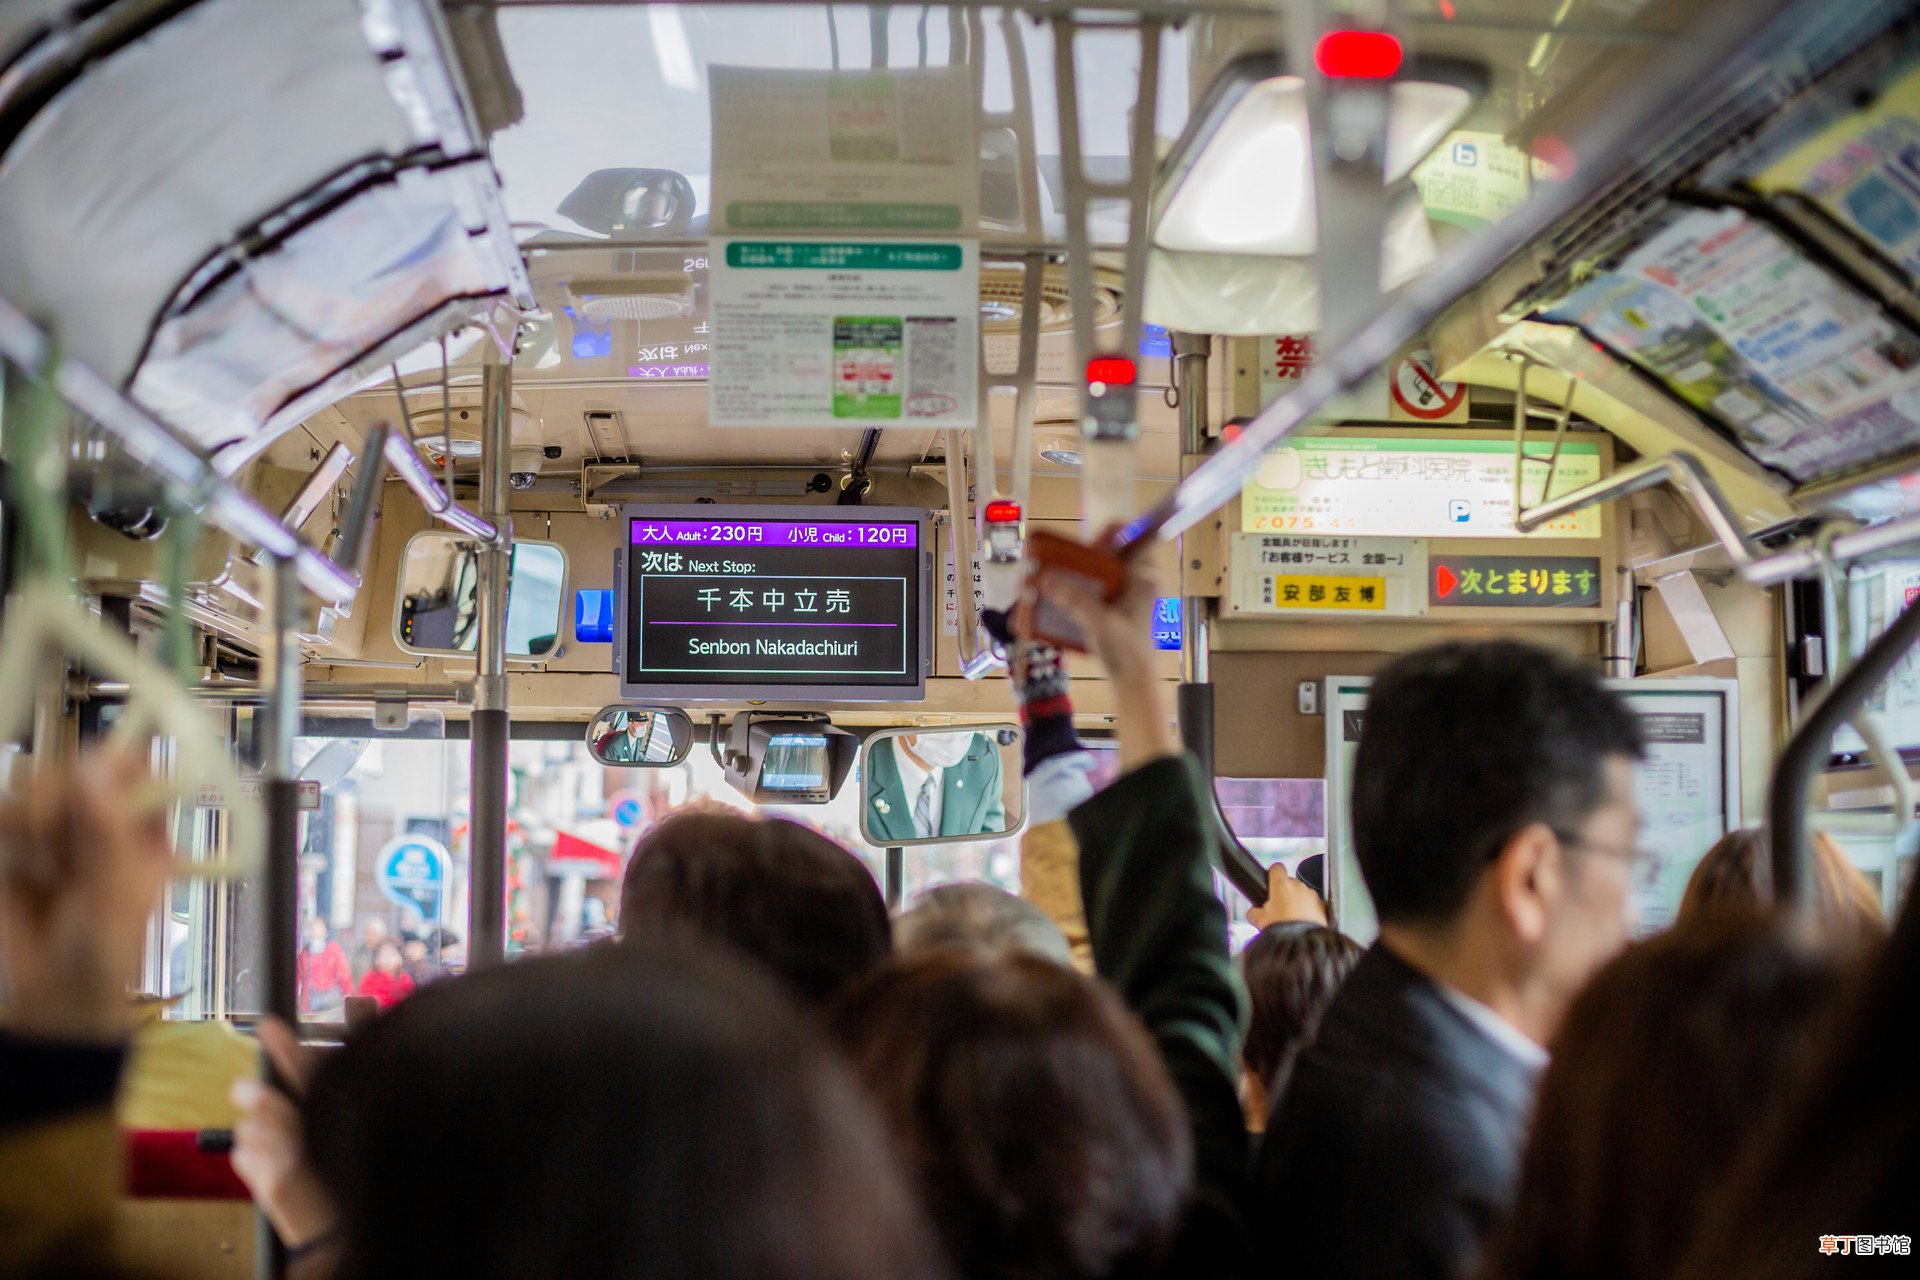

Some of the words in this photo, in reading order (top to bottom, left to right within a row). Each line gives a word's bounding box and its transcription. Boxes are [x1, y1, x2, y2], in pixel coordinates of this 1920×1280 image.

[642, 525, 673, 542] 大人
[787, 527, 819, 543] 小児
[641, 551, 683, 573] 次は
[688, 560, 720, 573] Next
[722, 560, 756, 575] Stop:
[1460, 568, 1597, 595] 次とまります
[696, 587, 851, 614] 千本中立売
[1283, 584, 1376, 603] 安部友博
[688, 638, 750, 655] Senbon
[755, 638, 858, 656] Nakadachiuri
